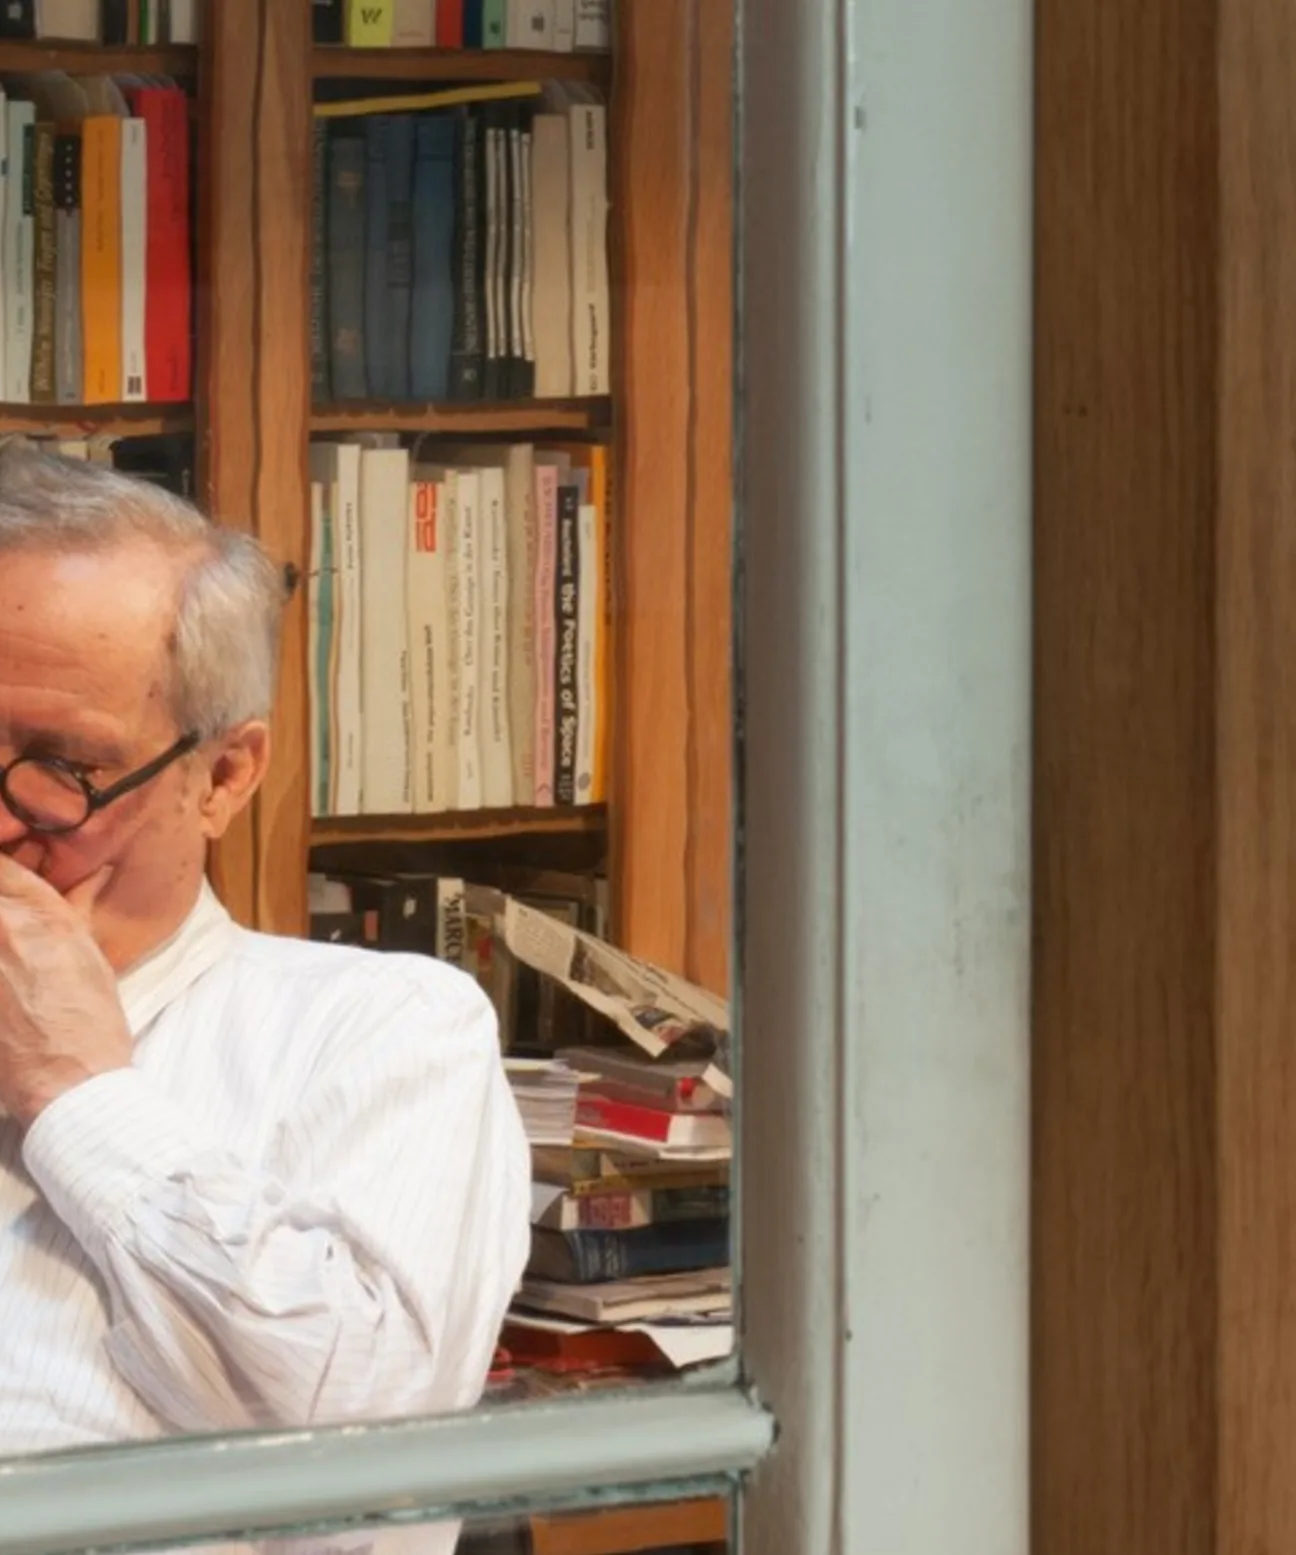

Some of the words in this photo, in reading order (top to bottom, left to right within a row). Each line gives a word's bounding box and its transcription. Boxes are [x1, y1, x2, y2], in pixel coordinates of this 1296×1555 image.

[561, 582, 574, 614] the
[562, 619, 576, 685] Poetics
[561, 688, 576, 711] of
[560, 715, 576, 767] Space
